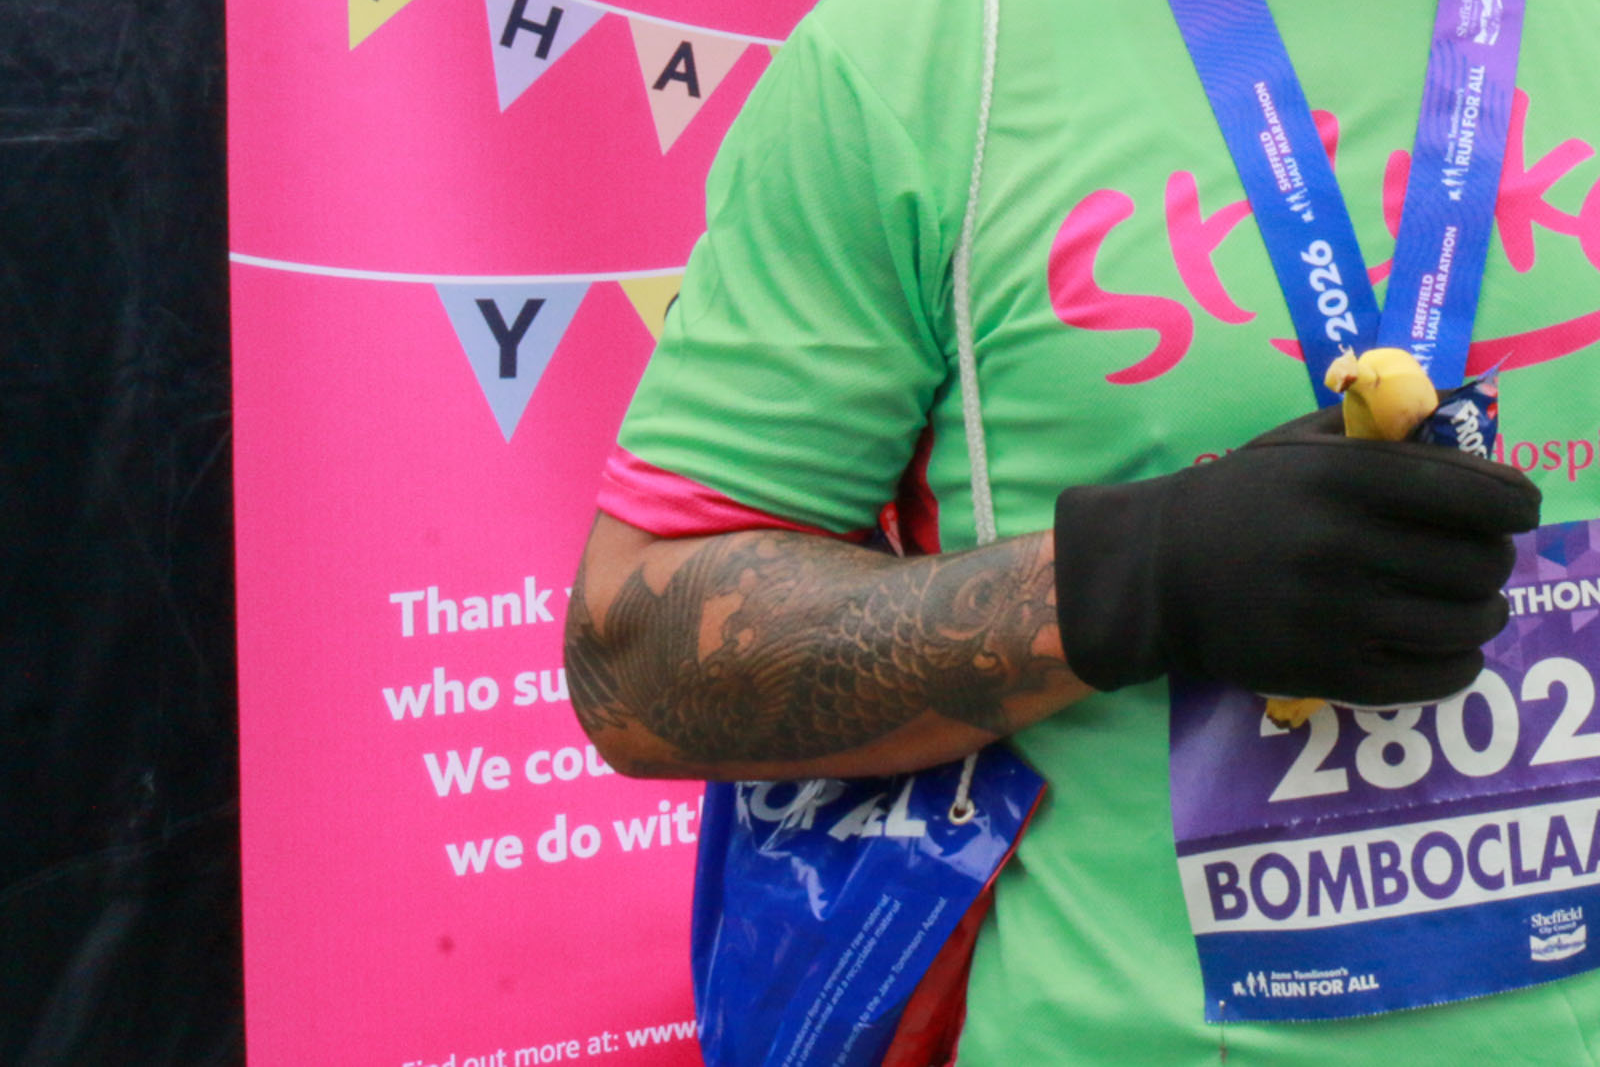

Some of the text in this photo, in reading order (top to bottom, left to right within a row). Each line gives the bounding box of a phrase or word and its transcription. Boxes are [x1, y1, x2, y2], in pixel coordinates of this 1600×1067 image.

[1254, 82, 1304, 187] HALF MARATHON
[1455, 64, 1484, 166] RUN FOR ALL
[1259, 131, 1292, 193] SHEFFIELD
[1300, 239, 1358, 342] 2026
[1411, 274, 1434, 338] SHEFFIELD
[1425, 226, 1458, 340] HALF MARATHON
[389, 576, 554, 636] Thank
[382, 667, 499, 720] who
[423, 747, 510, 797] We
[445, 834, 523, 876] we
[536, 813, 601, 863] do
[1531, 906, 1583, 928] Sheffield
[1271, 974, 1380, 997] RUN FOR ALL
[513, 1040, 580, 1067] more
[587, 1031, 620, 1055] at:
